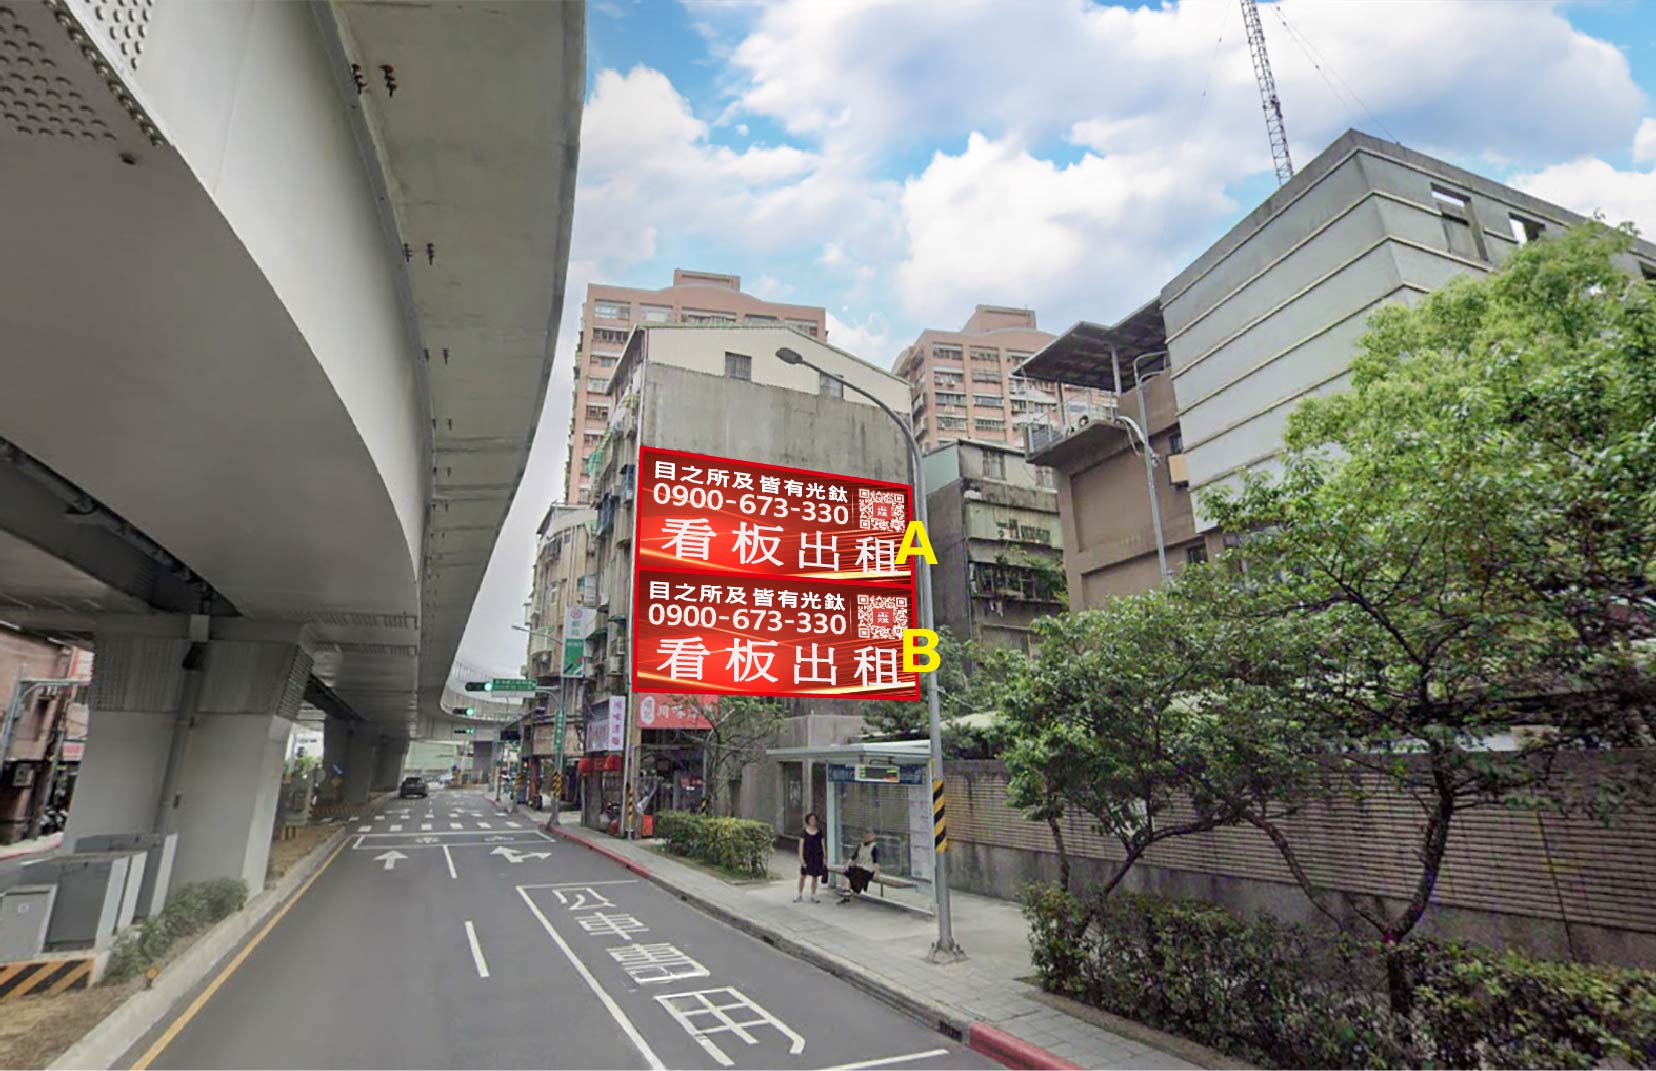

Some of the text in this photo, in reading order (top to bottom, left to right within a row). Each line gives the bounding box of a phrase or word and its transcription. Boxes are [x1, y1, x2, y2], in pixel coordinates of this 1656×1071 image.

[652, 482, 849, 525] 0900-673-330
[660, 517, 899, 575] 看板出租
[648, 603, 847, 635] 0900-673-330
[656, 636, 901, 688] 看板出租
[552, 887, 806, 1067] 公車專用
